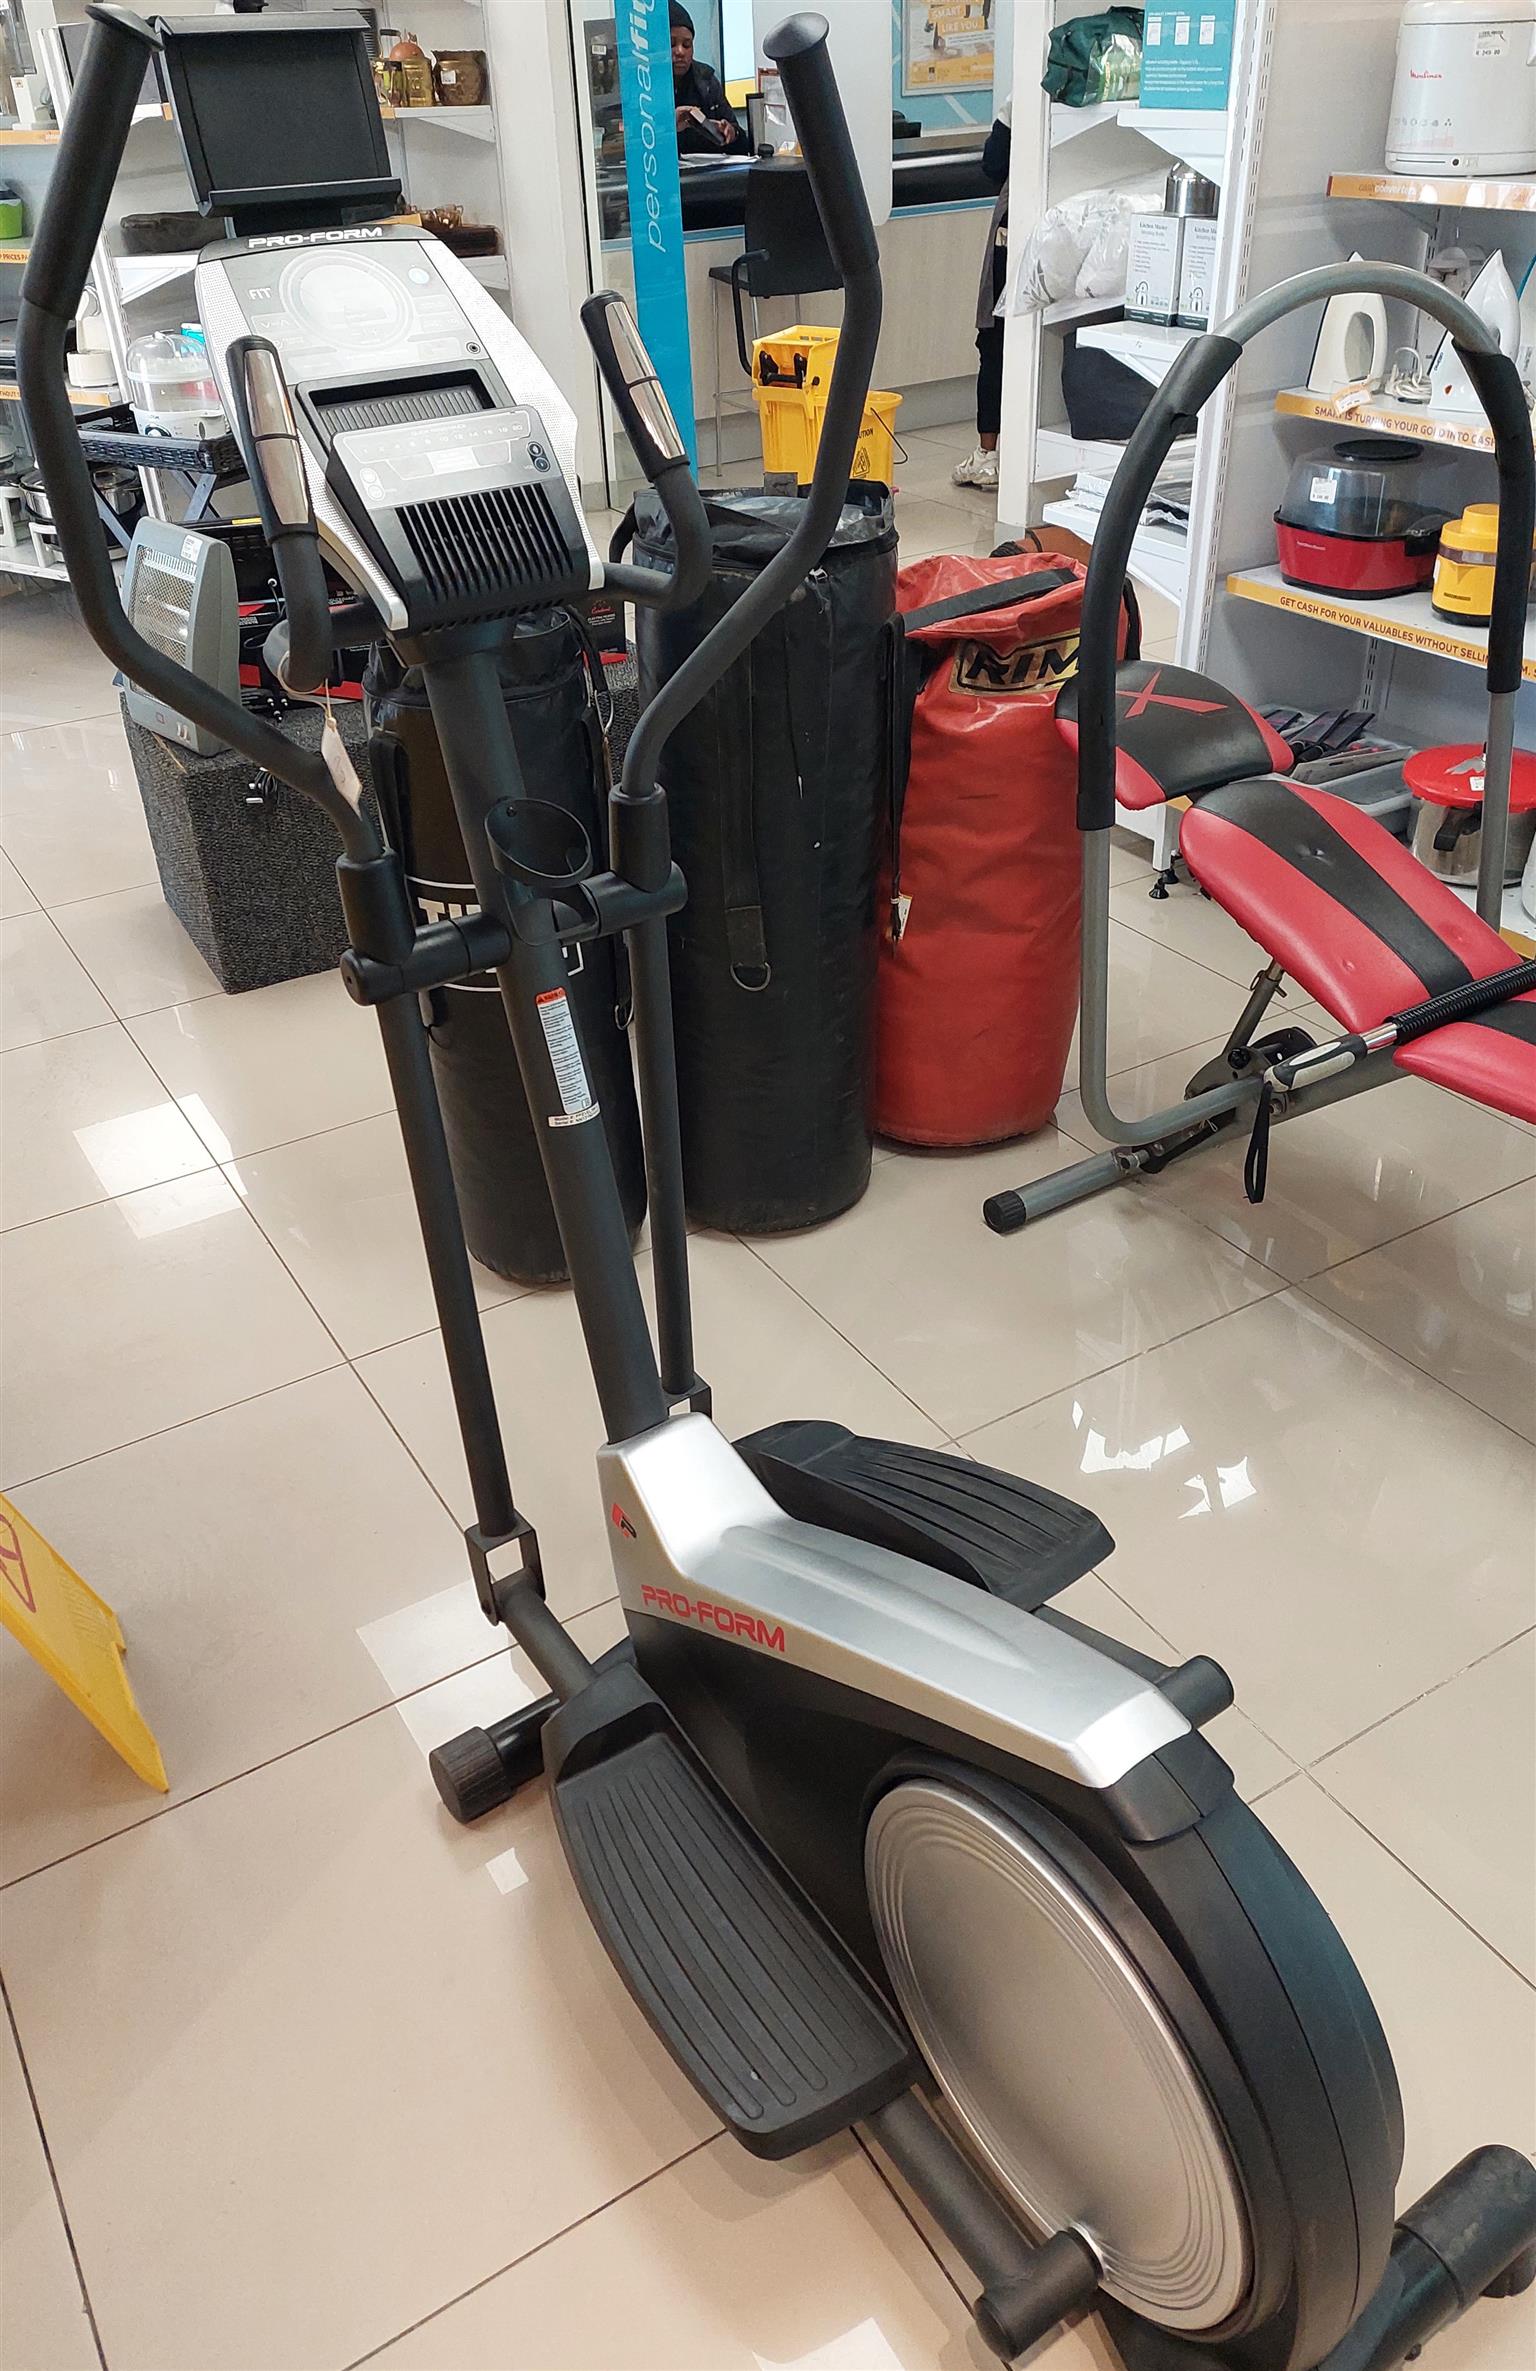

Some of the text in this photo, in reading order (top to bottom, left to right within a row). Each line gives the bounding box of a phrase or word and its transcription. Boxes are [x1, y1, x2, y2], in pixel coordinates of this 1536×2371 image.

[248, 227, 382, 248] PRO-FORM
[1394, 419, 1419, 433] YOUR
[1280, 596, 1295, 607] GET
[1297, 601, 1319, 614] CASH
[1320, 607, 1337, 620] FOR
[1338, 613, 1361, 627] YOUR
[1363, 619, 1413, 643] VALUABLES
[1415, 634, 1459, 654] WITHOUT
[640, 1583, 785, 1653] PRO-FORM
